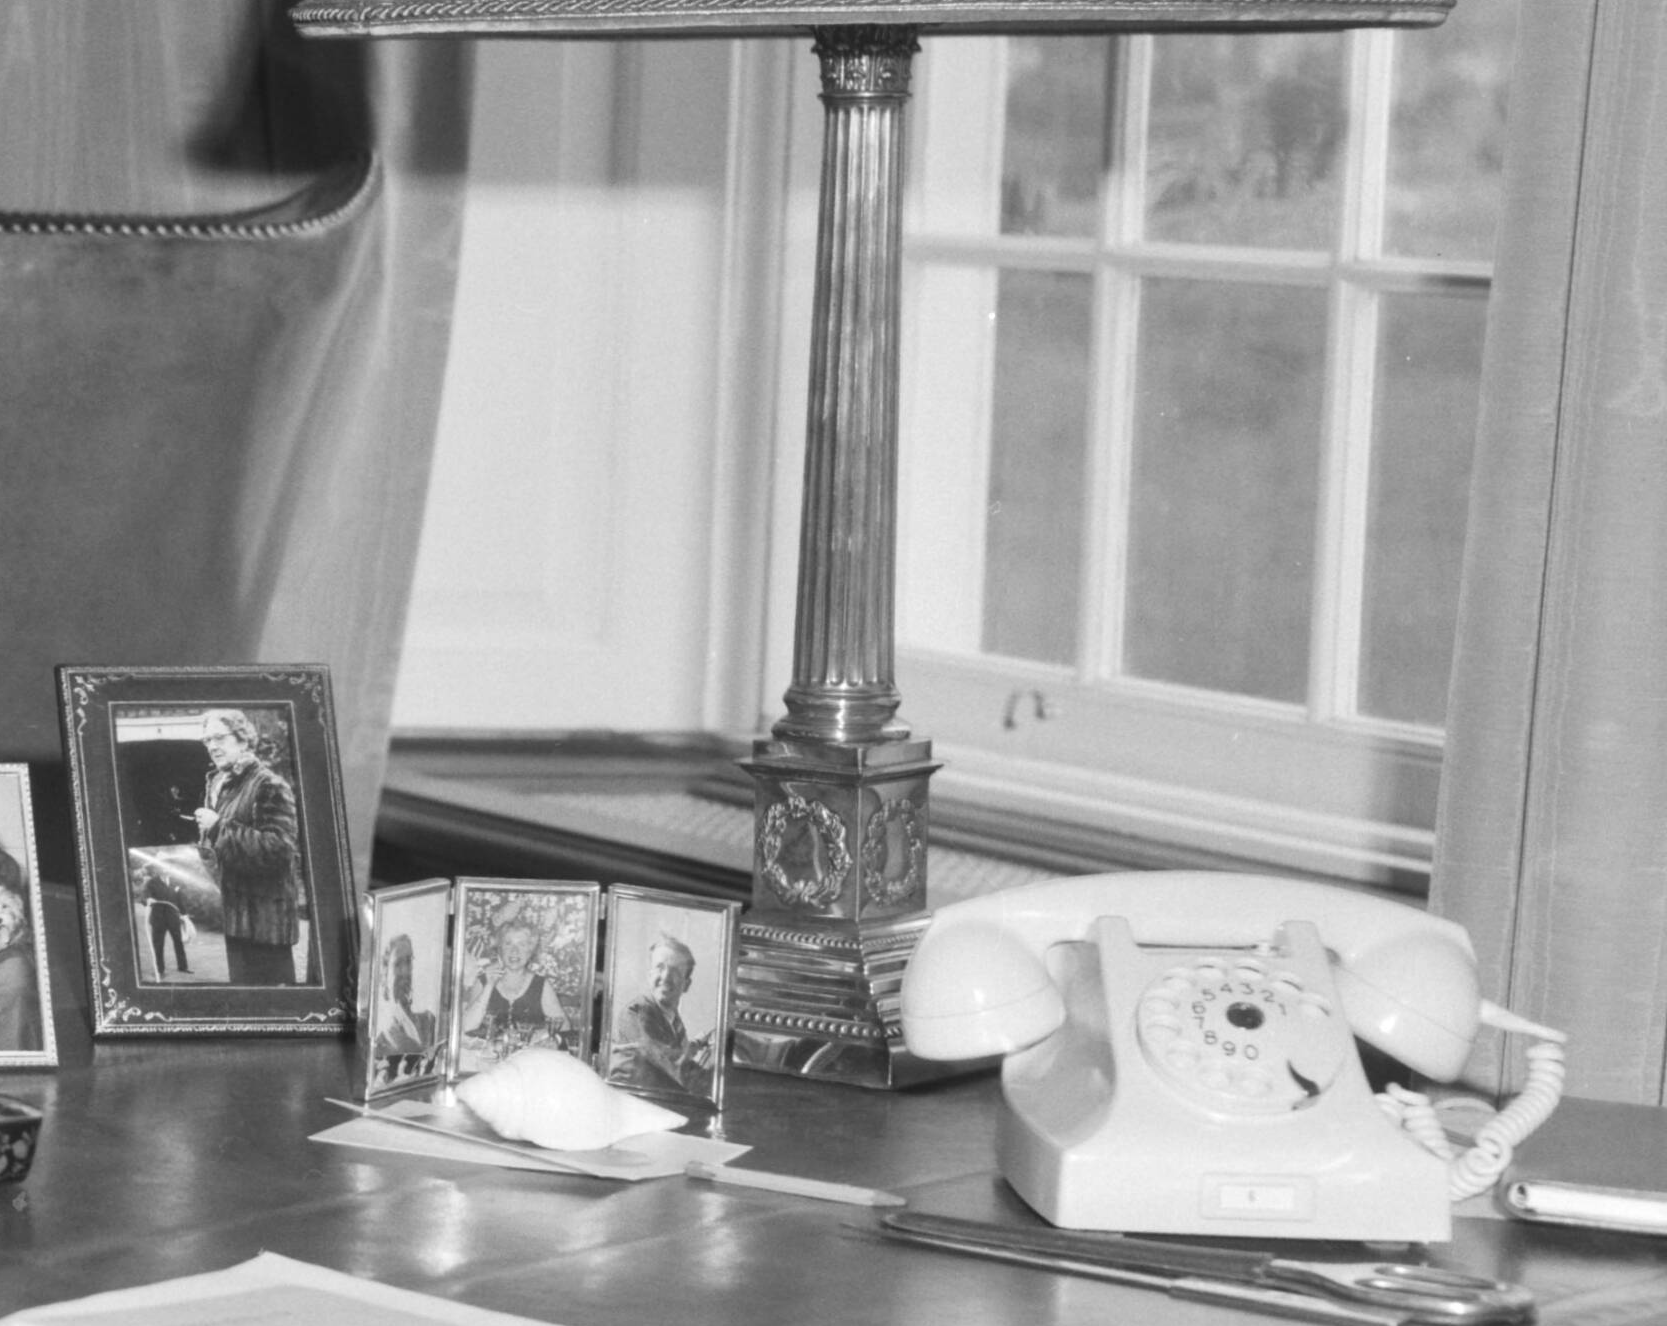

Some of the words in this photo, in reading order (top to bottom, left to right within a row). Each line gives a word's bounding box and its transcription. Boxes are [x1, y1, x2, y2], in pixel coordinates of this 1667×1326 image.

[1202, 988, 1216, 1002] 5
[1220, 983, 1233, 993] 4
[1240, 982, 1255, 995] 3
[1260, 989, 1275, 1003] 2
[1191, 1001, 1206, 1015] 6
[1278, 1003, 1287, 1017] 1
[1192, 1016, 1205, 1030] 7
[1203, 1030, 1218, 1045] 8
[1222, 1040, 1236, 1057] 9
